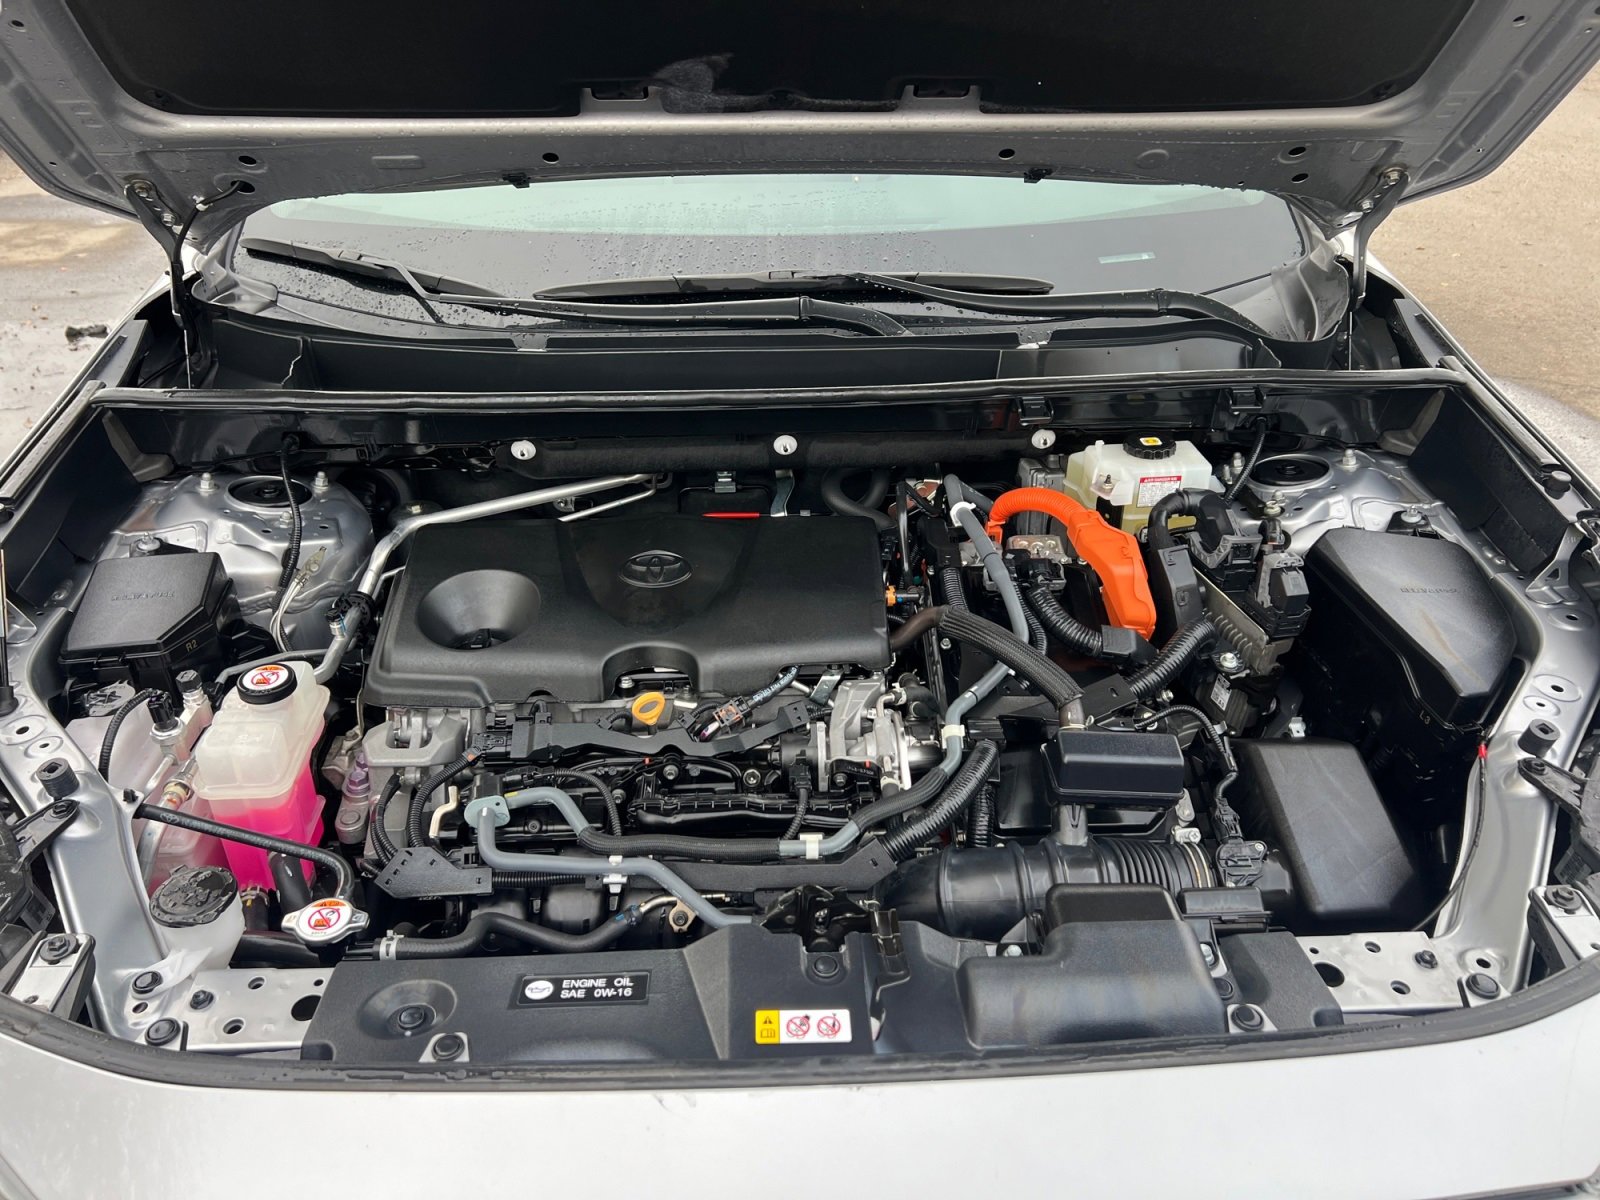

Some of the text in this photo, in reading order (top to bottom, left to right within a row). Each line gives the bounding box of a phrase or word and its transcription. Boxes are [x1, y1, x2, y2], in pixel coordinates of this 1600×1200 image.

[185, 640, 198, 652] R2
[1419, 710, 1430, 724] L3
[562, 977, 634, 988] ENGINE OIL
[560, 987, 632, 999] SAE 0W-16
